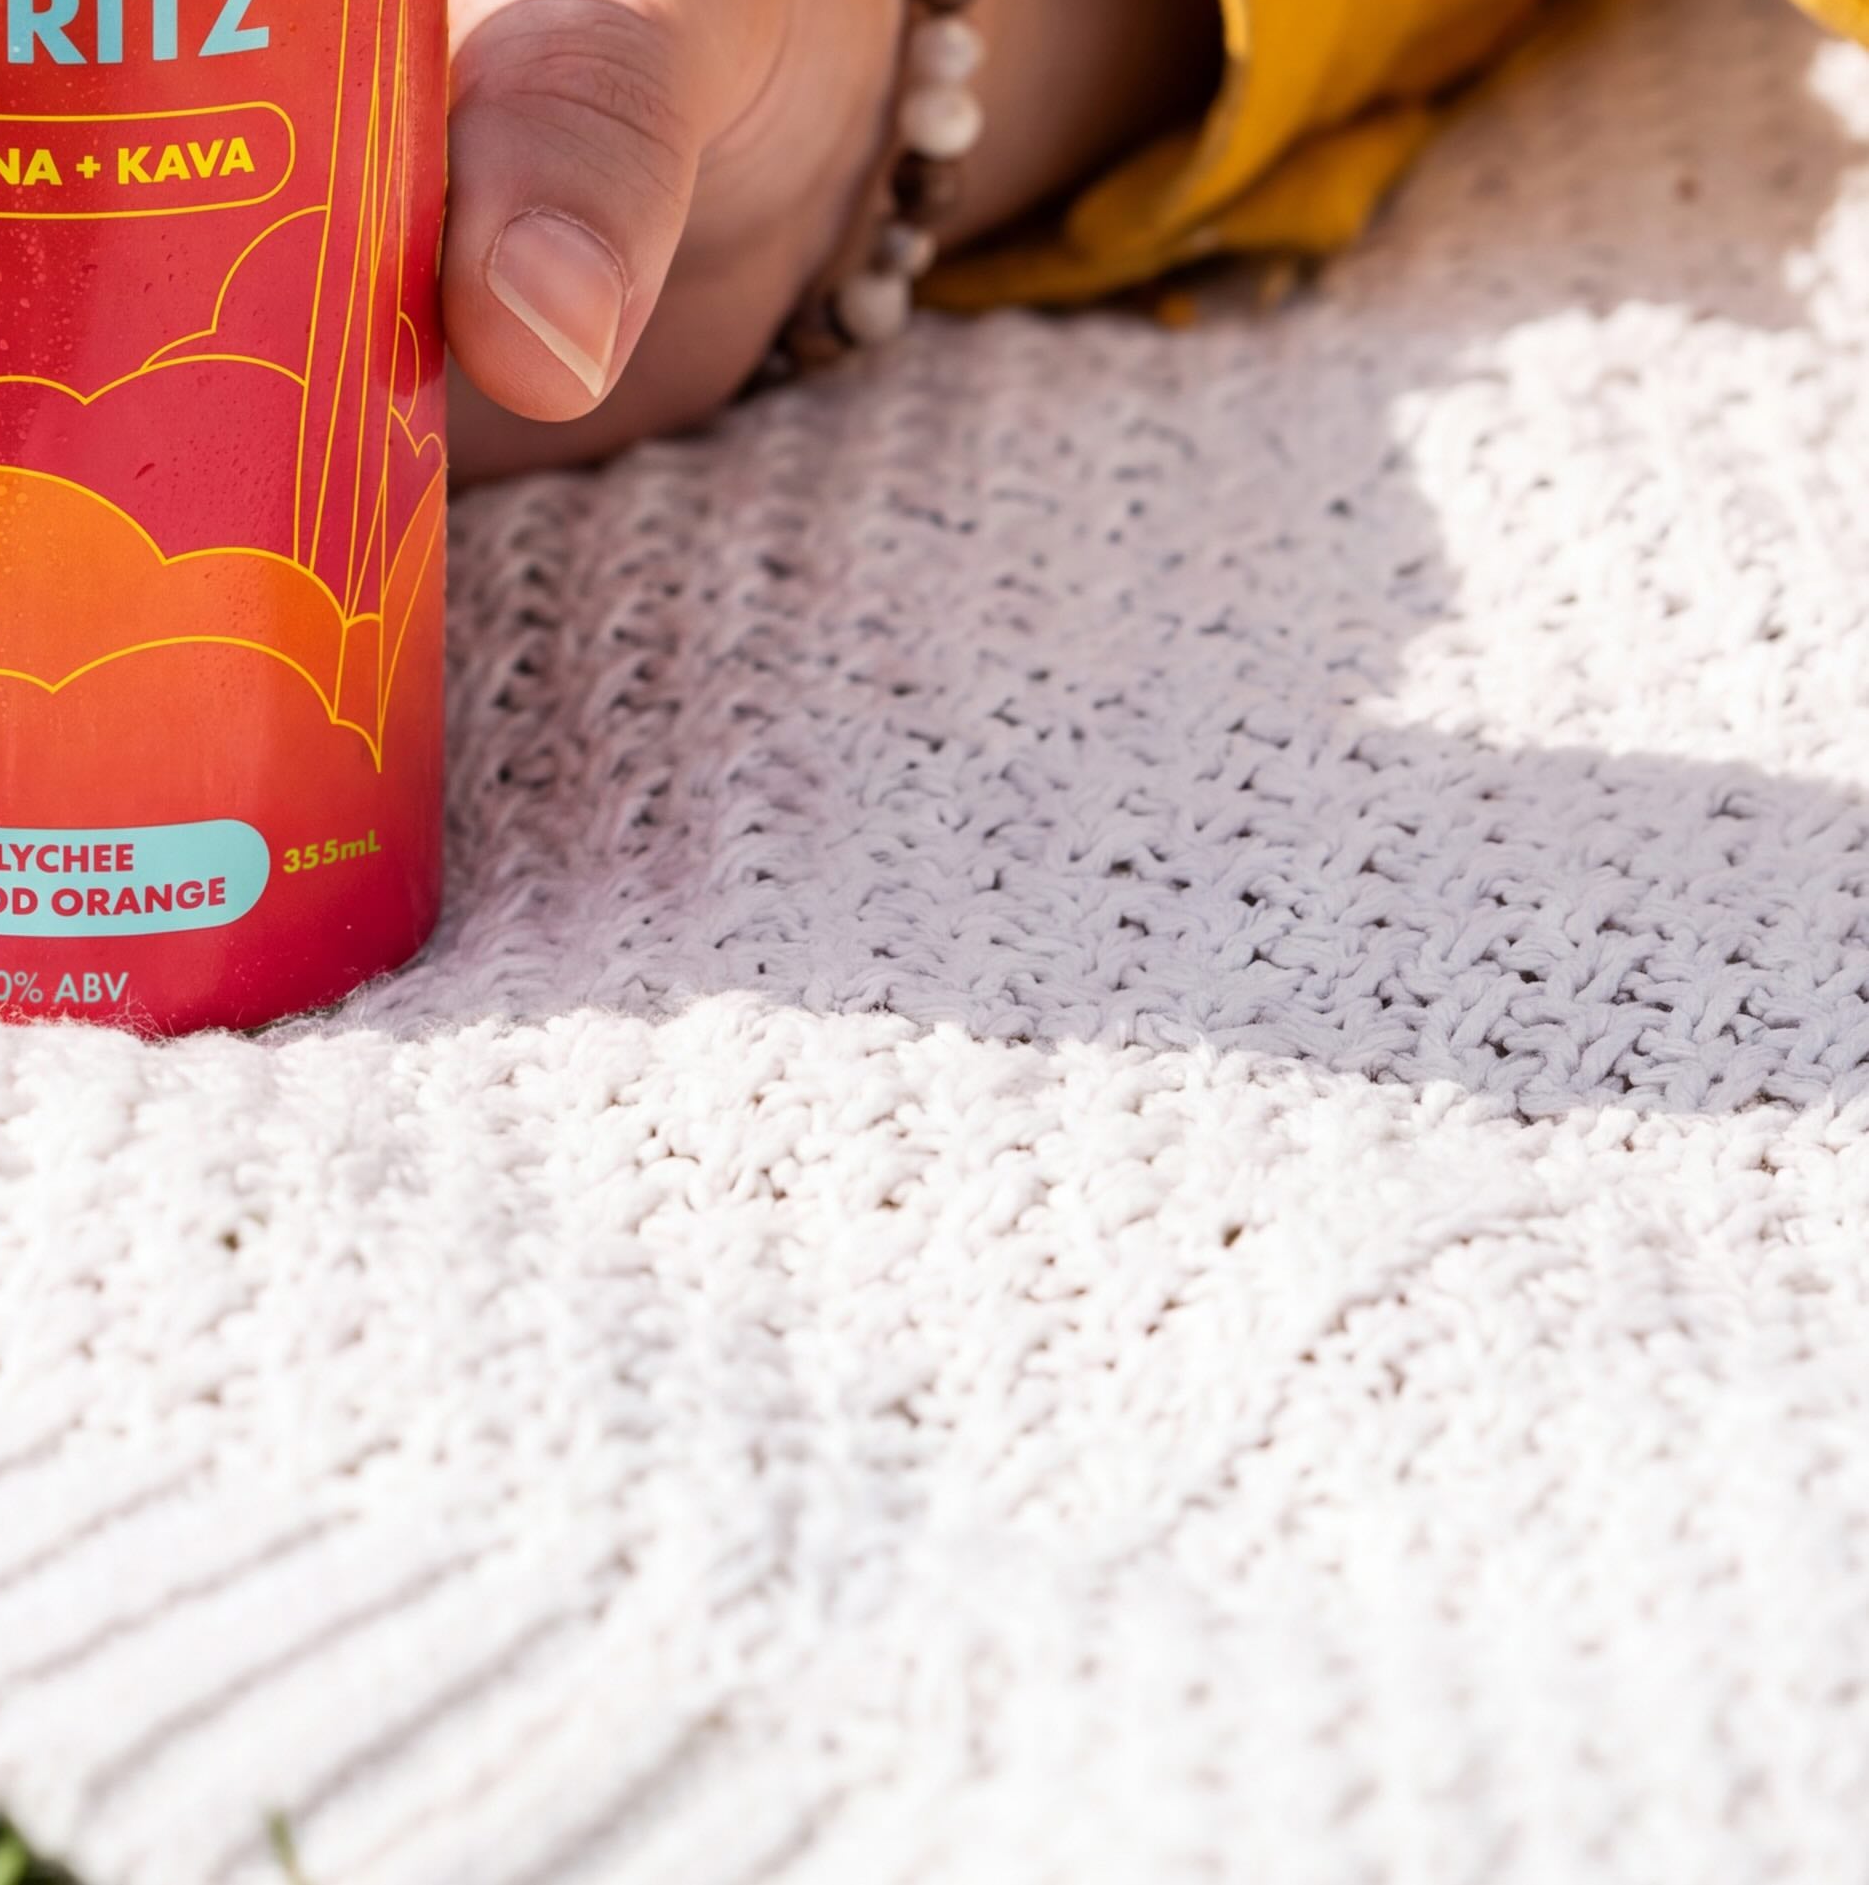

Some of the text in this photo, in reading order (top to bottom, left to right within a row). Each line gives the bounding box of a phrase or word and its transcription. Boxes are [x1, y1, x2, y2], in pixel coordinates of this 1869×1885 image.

[118, 136, 255, 185] KAVA
[283, 829, 382, 874] 355mL
[51, 876, 226, 917] ORANGE
[54, 972, 129, 1003] ABV
